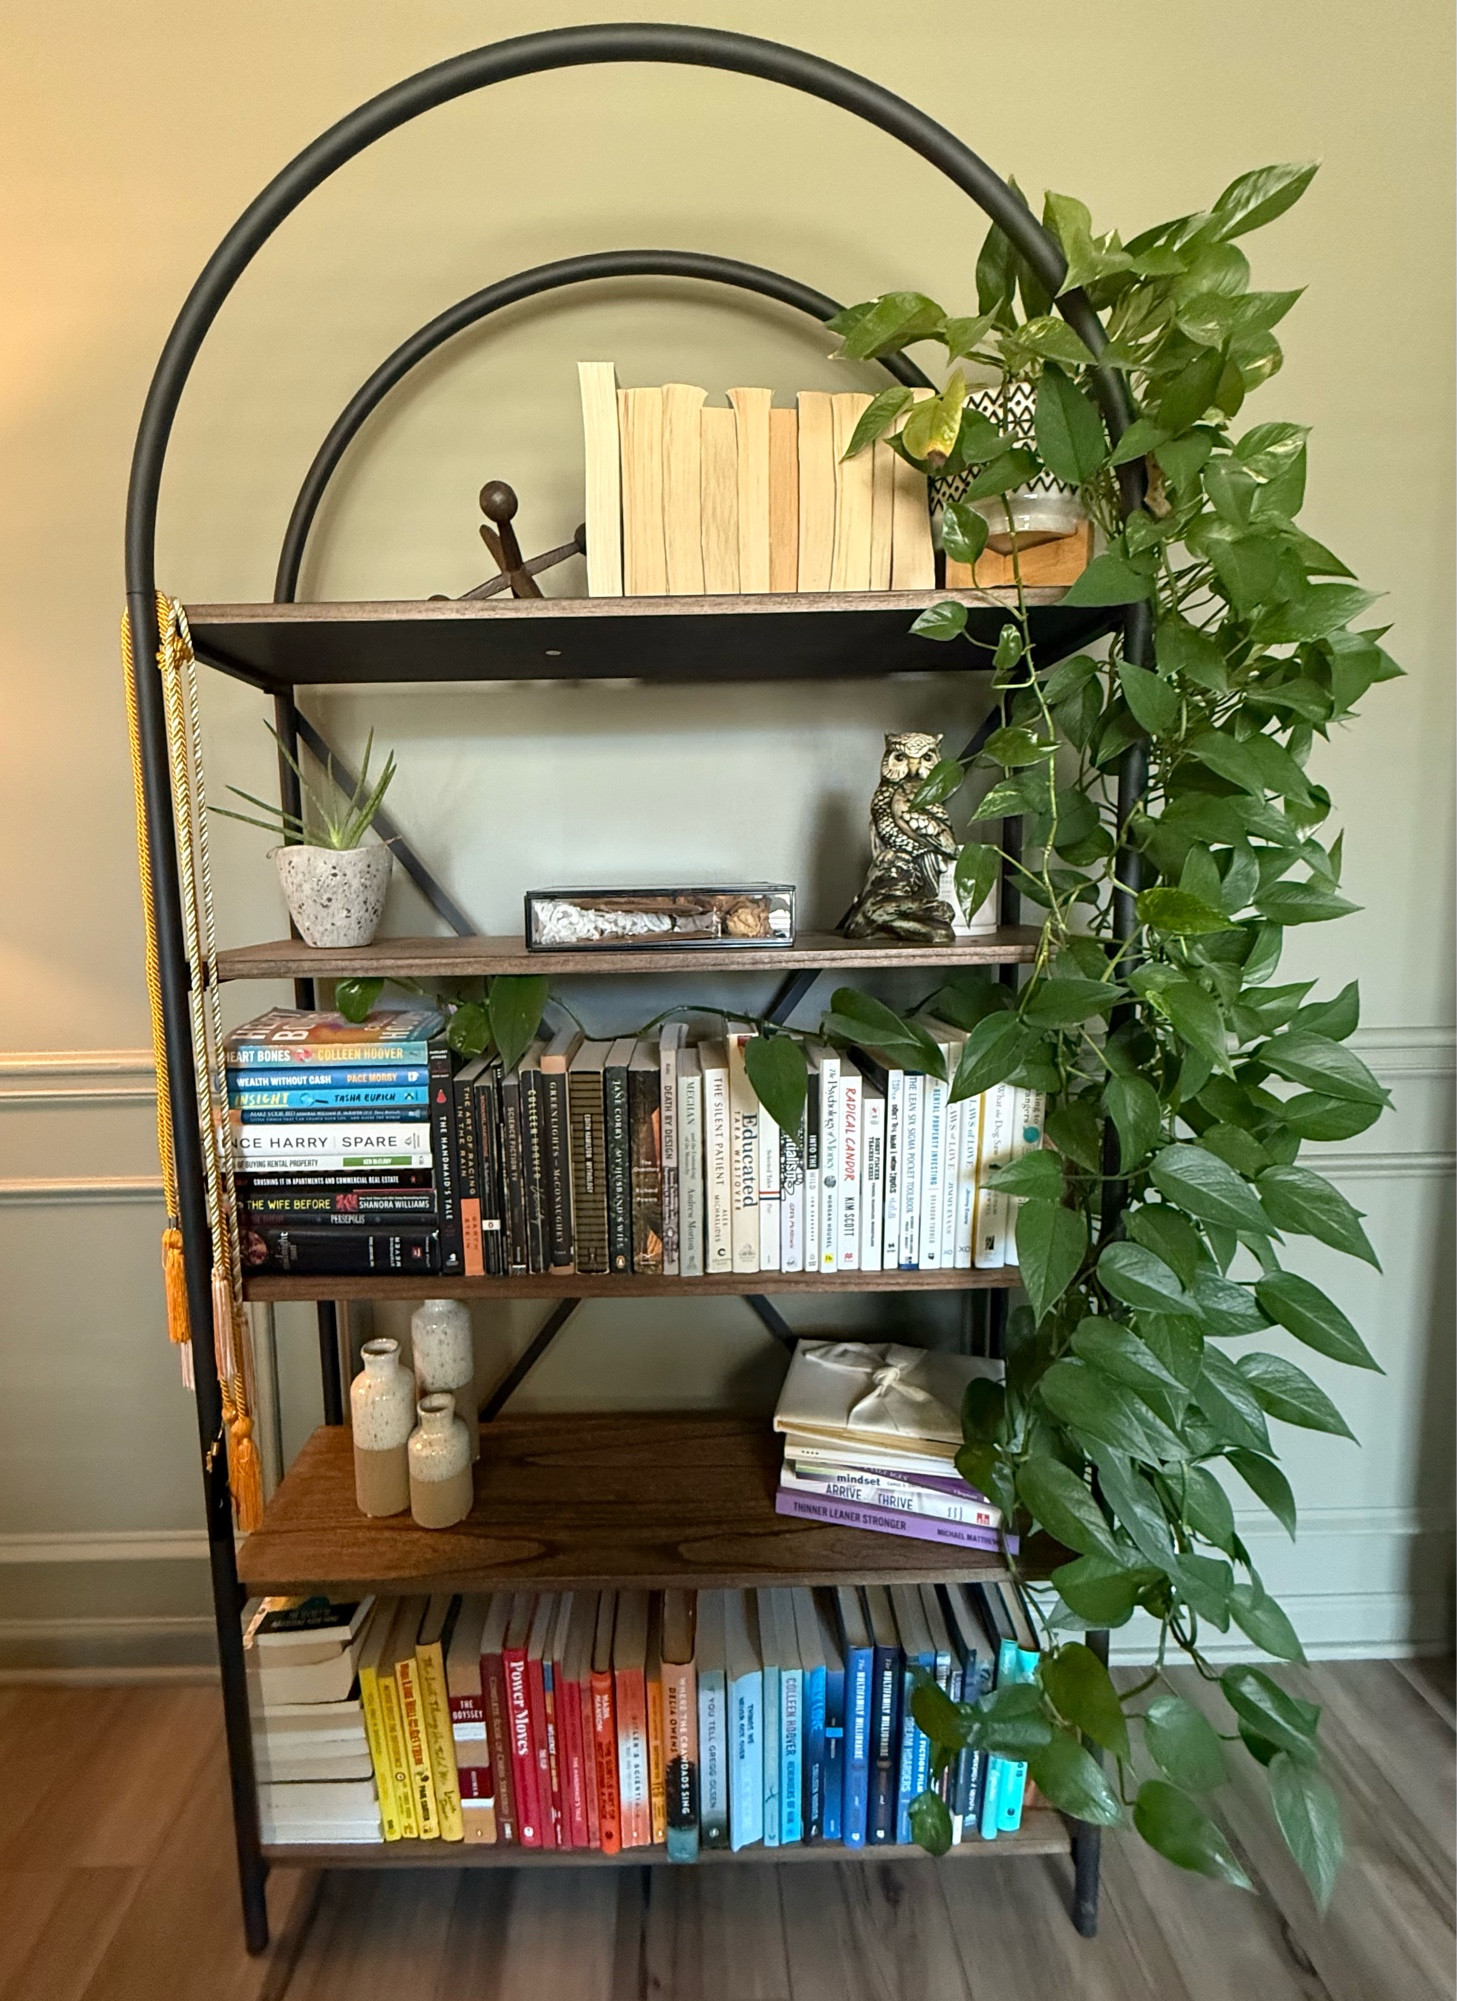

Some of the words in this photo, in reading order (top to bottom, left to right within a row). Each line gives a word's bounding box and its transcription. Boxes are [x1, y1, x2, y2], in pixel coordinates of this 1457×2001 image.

[258, 1050, 290, 1062] BONES
[318, 1049, 360, 1060] COLLEEN
[364, 1048, 403, 1059] HOOVER
[237, 1078, 269, 1087] WEALTH
[270, 1076, 307, 1086] WITHOUT
[309, 1075, 331, 1084] CASH
[346, 1074, 367, 1083] PACE
[713, 1077, 723, 1098] THE
[908, 1077, 917, 1091] THE
[235, 1092, 289, 1106] INSIGHT
[334, 1094, 361, 1103] TASHA
[364, 1093, 396, 1102] EURICH
[463, 1086, 471, 1107] THE
[613, 1080, 622, 1105] JANE
[664, 1085, 672, 1112] DEATH
[685, 1081, 695, 1125] MEGHAN
[825, 1080, 838, 1131] Psychology
[908, 1093, 917, 1112] LEAN
[932, 1088, 941, 1113] RENTAL
[995, 1085, 1005, 1108] What
[457, 1105, 463, 1116] IN
[507, 1107, 515, 1139] SCIENCE
[527, 1090, 538, 1135] COLLEEN
[549, 1081, 560, 1157] GREENLIGHTS
[584, 1114, 593, 1131] EDITH
[614, 1108, 622, 1140] CORRY
[665, 1115, 673, 1126] BY
[714, 1102, 724, 1137] SILENT
[845, 1088, 856, 1134] RADICAL
[908, 1114, 917, 1125] SIX
[967, 1100, 977, 1127] LAWS
[1033, 1114, 1039, 1125] to
[439, 1116, 448, 1133] THE
[931, 1115, 940, 1149] PROPERTY
[991, 1120, 1002, 1139] Dog
[270, 1137, 328, 1148] HARRY
[342, 1136, 398, 1147] SPARE
[466, 1135, 473, 1149] OF
[585, 1131, 593, 1158] HAMILTON
[665, 1129, 673, 1160] DESIGN
[809, 1135, 817, 1158] INTO
[907, 1128, 917, 1150] SIGMA
[245, 1160, 266, 1169] BUYING
[267, 1160, 288, 1168] RENTAL
[290, 1159, 318, 1167] PROPERTY
[440, 1137, 452, 1195] HANDMAID'S
[459, 1150, 467, 1177] RAIN
[509, 1141, 517, 1171] FICTION
[531, 1138, 541, 1180] HOOVER
[714, 1143, 724, 1185] PATIENT
[741, 1113, 758, 1208] Educated
[826, 1138, 835, 1171] Money
[844, 1137, 855, 1181] CANDOR
[906, 1152, 916, 1179] POCKET
[930, 1150, 938, 1185] INVESTING
[947, 1142, 955, 1171] LOVE
[965, 1140, 975, 1168] LOVE
[293, 1177, 324, 1185] APARTMENTS
[336, 1176, 367, 1184] COMMERCIAL
[369, 1176, 380, 1184] REAL
[467, 1153, 476, 1195] RACING
[511, 1172, 518, 1181] TV
[585, 1161, 594, 1193] MYTHOLOGY
[247, 1200, 264, 1210] THE
[268, 1200, 291, 1210] WIFE
[294, 1199, 331, 1210] BEFORE
[359, 1201, 393, 1209] SHANORA
[395, 1200, 430, 1208] WILLIAMS
[552, 1169, 564, 1244] McCONAUGHEY
[615, 1166, 624, 1223] HUSBAND'S
[687, 1187, 695, 1219] Andrew
[844, 1197, 855, 1210] KIM
[905, 1181, 915, 1214] TOOLBOOK
[330, 1214, 365, 1224] PERSEPOLIS
[444, 1199, 453, 1220] TALE
[687, 1220, 696, 1250] Morton
[844, 1213, 854, 1236] SCOTT
[837, 1474, 881, 1486] mindset
[826, 1484, 862, 1500] ARRIVE
[878, 1494, 913, 1509] THRIVE
[793, 1502, 828, 1516] THINNER
[829, 1508, 861, 1522] LEANER
[862, 1514, 907, 1530] STRONGER
[937, 1528, 965, 1540] MICHAEL
[510, 1661, 526, 1708] Power
[678, 1677, 687, 1712] WHERE
[786, 1678, 797, 1717] COLLEEN
[855, 1672, 866, 1715] MULTIFAMILY
[882, 1671, 893, 1714] MULTIFAMILY
[452, 1710, 484, 1720] ODYSSEY
[460, 1700, 473, 1709] THE
[595, 1695, 603, 1732] MANSON
[602, 1694, 610, 1719] MARK
[669, 1688, 677, 1715] DELIA
[515, 1709, 530, 1755] Moves
[670, 1719, 678, 1753] OWENS
[748, 1734, 754, 1745] WE
[785, 1720, 797, 1756] HOOVER
[854, 1717, 864, 1759] MILLIONAIRE
[880, 1715, 890, 1757] MILLIONAIRE
[904, 1716, 915, 1746] DREAM
[680, 1736, 689, 1789] CRAWDADS
[917, 1740, 927, 1773] FICTION
[901, 1749, 914, 1792] HOARDERS
[917, 1774, 925, 1793] FILM
[652, 1782, 663, 1798] YES
[682, 1791, 690, 1815] SING
[787, 1801, 795, 1809] OF
